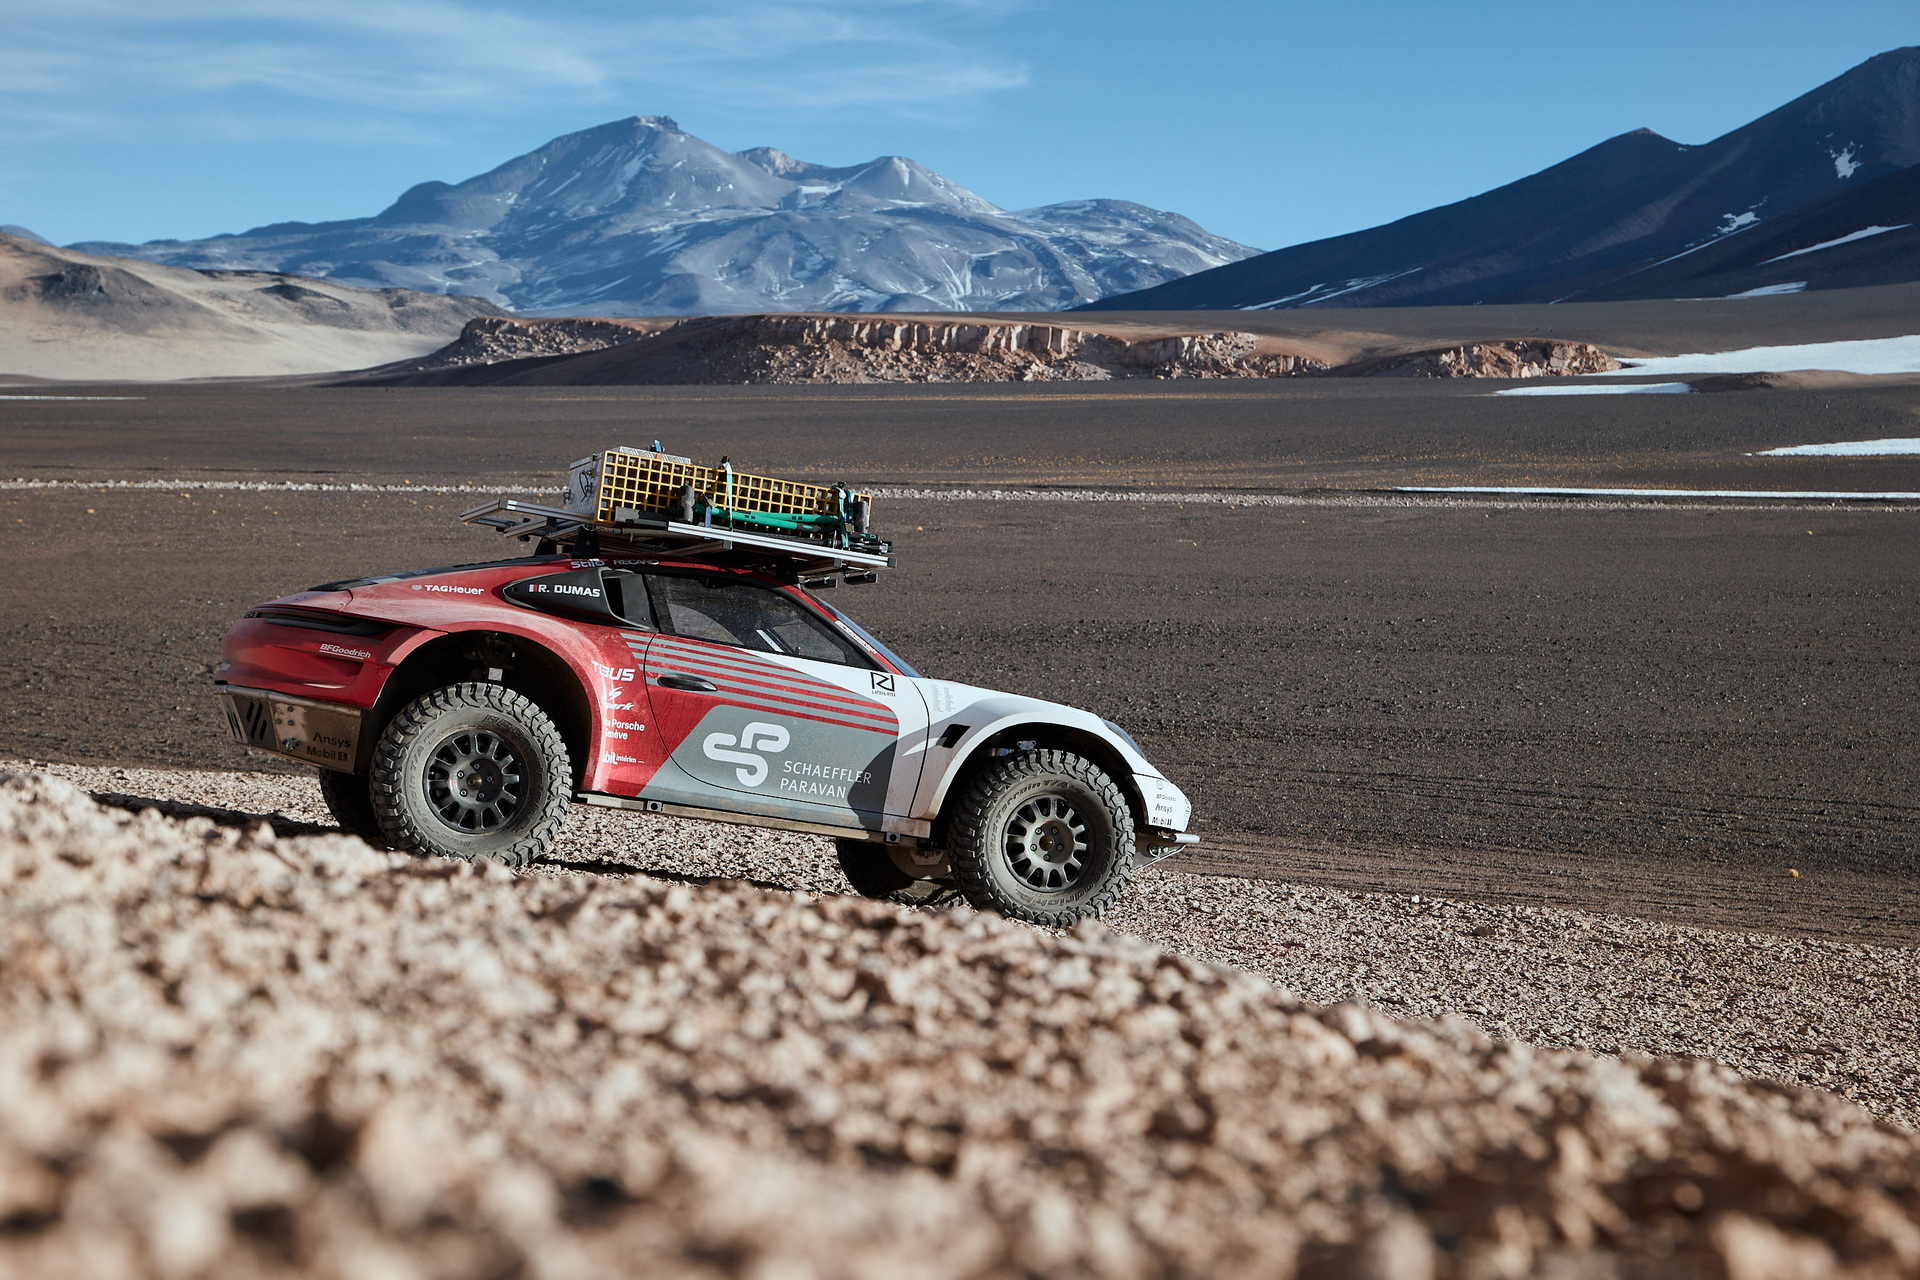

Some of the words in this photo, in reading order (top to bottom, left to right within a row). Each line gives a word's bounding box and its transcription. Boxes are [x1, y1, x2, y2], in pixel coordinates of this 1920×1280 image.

[538, 584, 550, 594] R.
[553, 584, 601, 598] DUMAS
[319, 643, 371, 660] BFGoodrich
[611, 718, 645, 732] Porsche
[312, 732, 351, 749] Ansys
[306, 745, 336, 760] Mobil
[782, 760, 872, 785] SCHAEFFLER
[780, 778, 847, 799] PARAVAN
